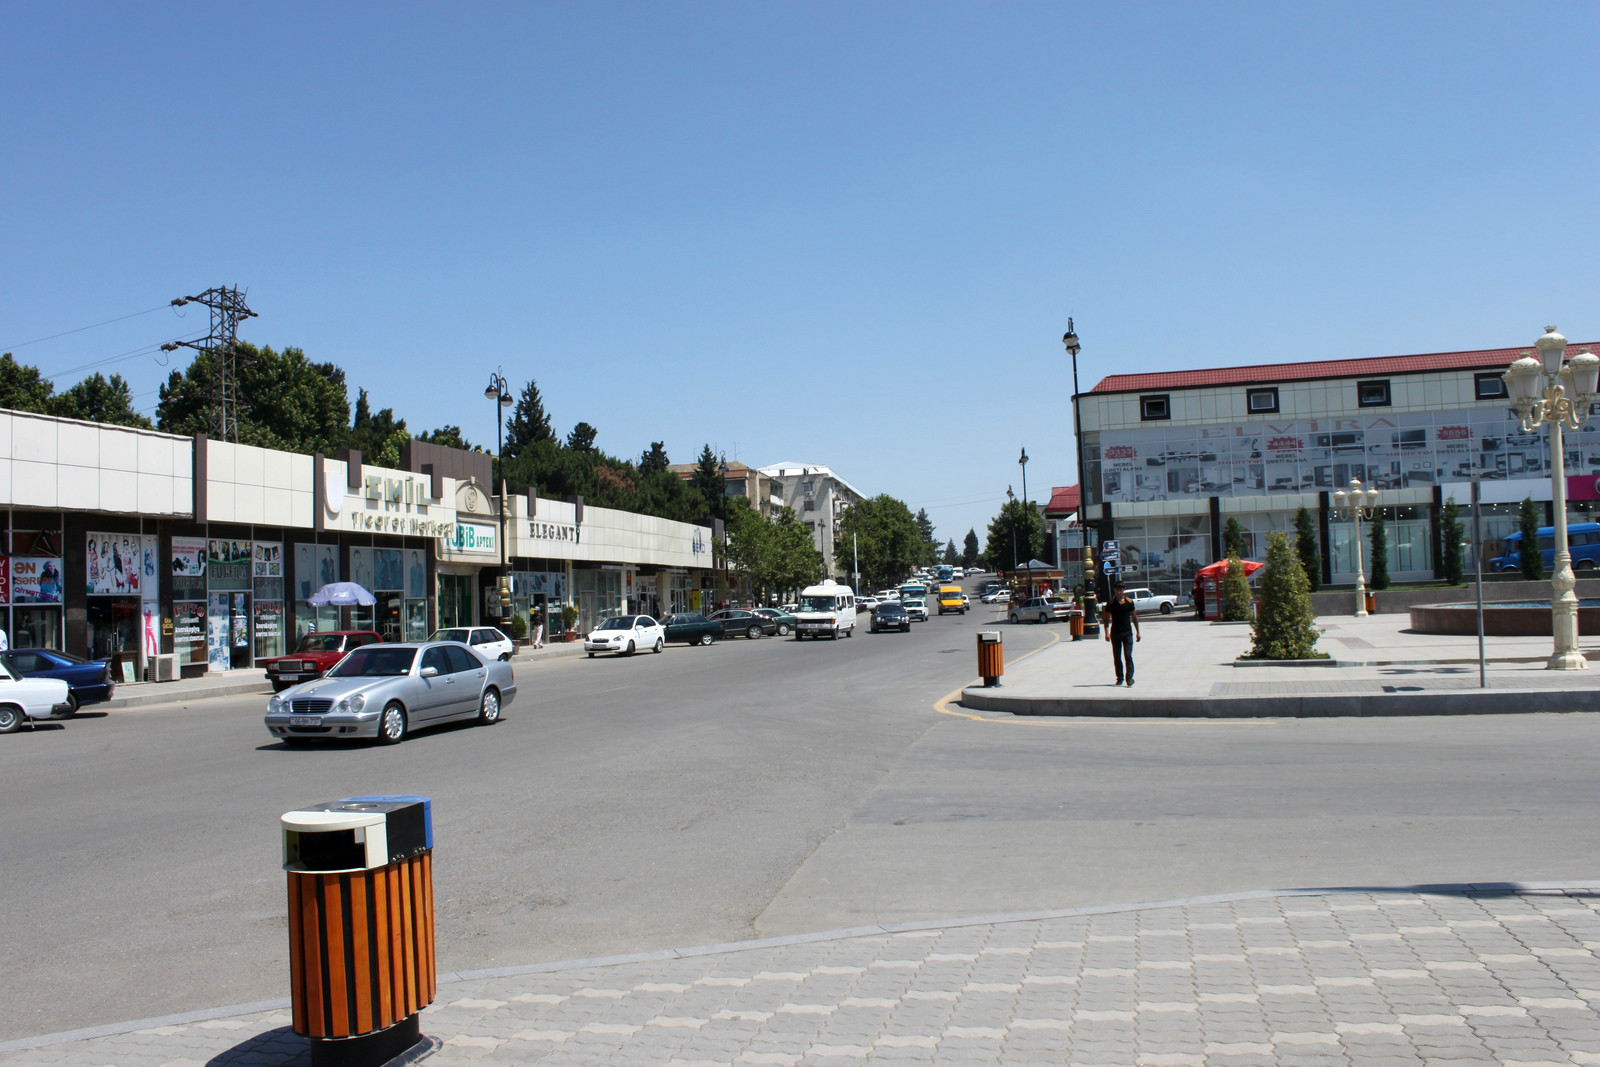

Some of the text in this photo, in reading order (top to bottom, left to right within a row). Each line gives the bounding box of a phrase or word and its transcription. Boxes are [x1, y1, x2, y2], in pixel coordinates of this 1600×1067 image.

[366, 475, 432, 506] EMİL
[529, 522, 575, 541] ELEGANT
[14, 561, 36, 575] ƏN
[174, 603, 205, 618] FOTO
